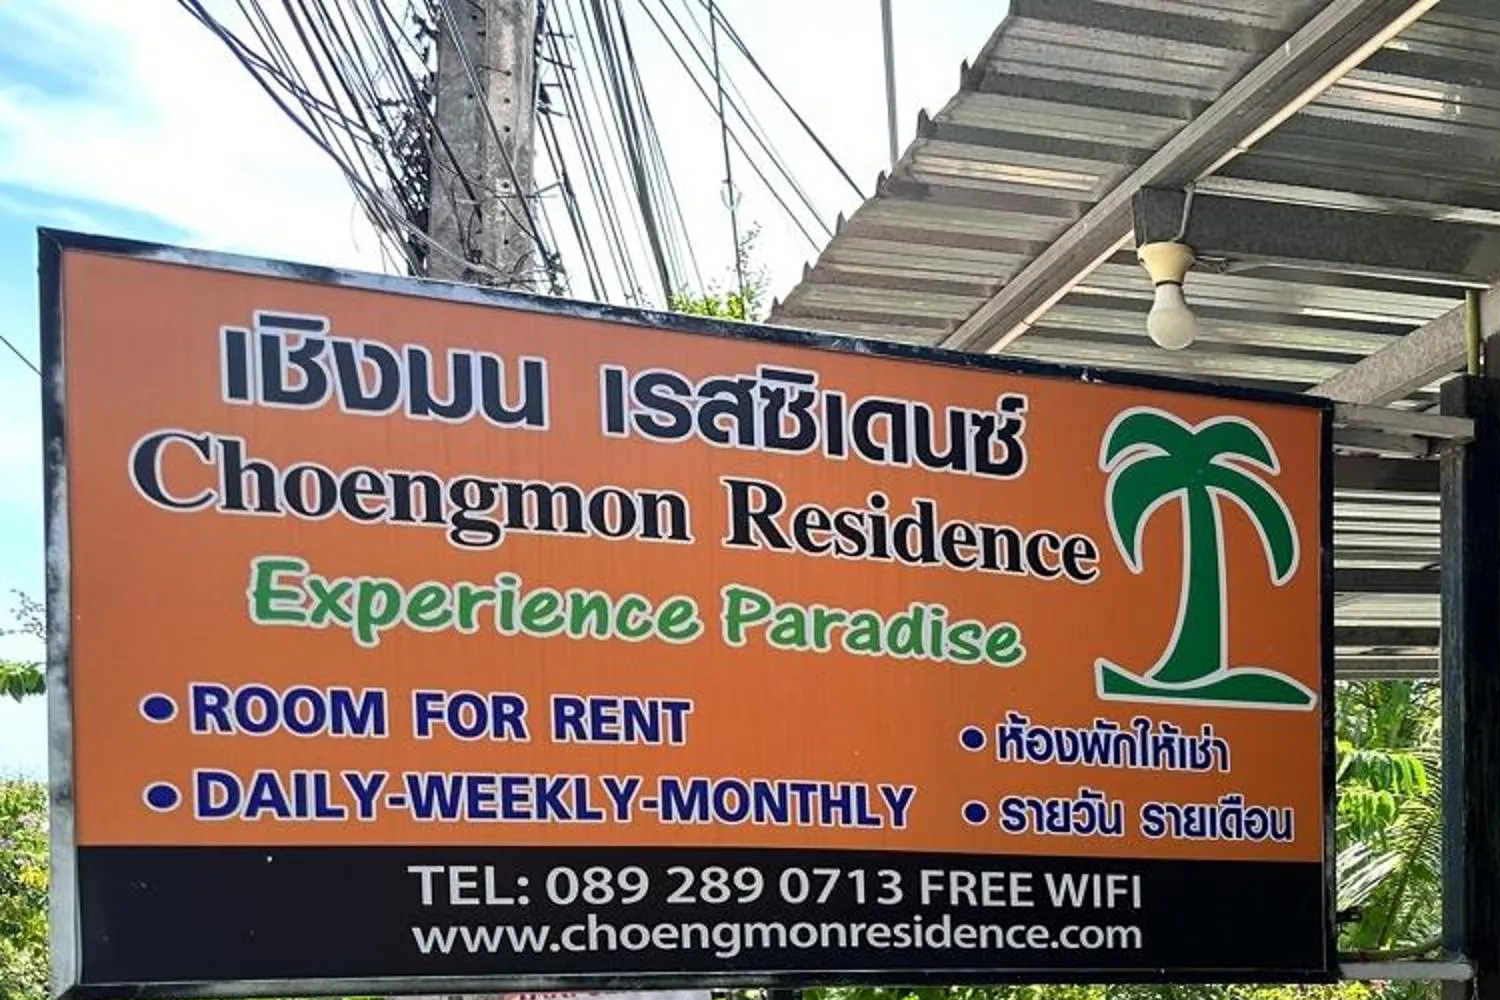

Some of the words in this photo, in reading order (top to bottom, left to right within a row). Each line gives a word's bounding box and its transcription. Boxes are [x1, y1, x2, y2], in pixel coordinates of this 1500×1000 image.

[223, 313, 547, 428] เชิงมน
[603, 367, 1026, 477] เรสซิเดนซ์
[131, 431, 694, 547] Choengmon
[722, 478, 1100, 581] Residence
[251, 558, 702, 645] Experience
[721, 586, 1025, 665] Paradise
[191, 684, 387, 737] ROOM
[414, 691, 528, 740] FOR
[552, 696, 692, 744] RENT
[998, 713, 1230, 772] ห้องพักให้เช่า
[196, 769, 915, 828] DAILY-WEEKLY-MONTHLY
[1001, 789, 1123, 835] รายวัน
[1141, 796, 1294, 841] รายเดือน
[408, 866, 530, 906] TEL:
[546, 866, 650, 905] 089
[666, 866, 764, 904] 289
[779, 867, 903, 905] 0713
[920, 869, 1034, 907] FREE
[1044, 873, 1142, 909] WIFI
[412, 914, 1142, 958] www.choengmonresidence.com
